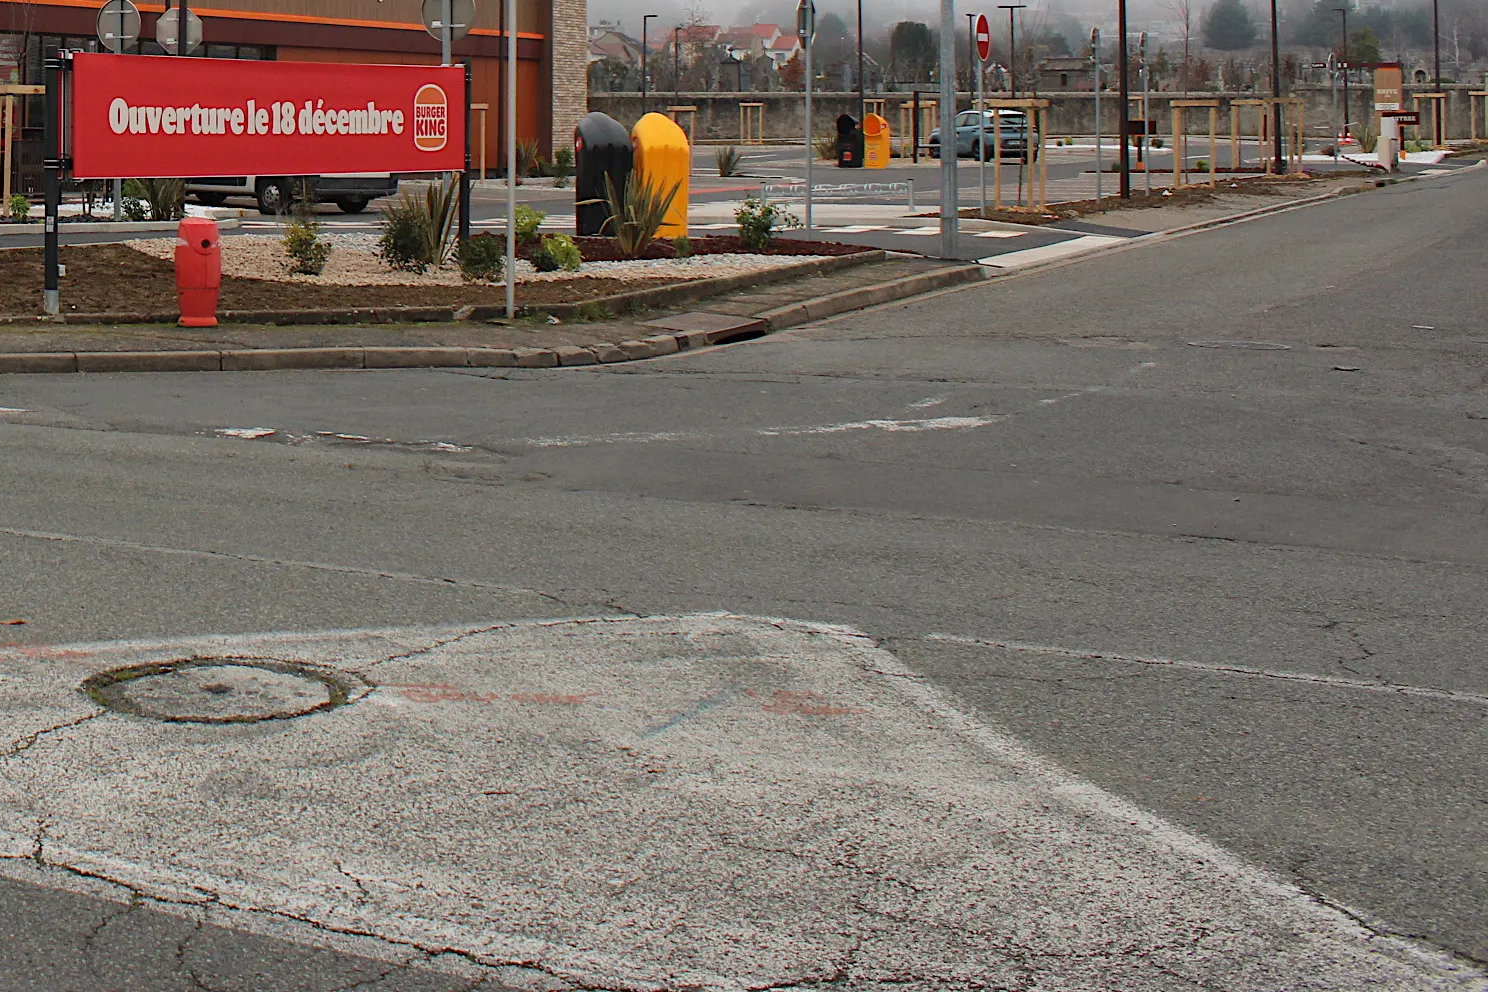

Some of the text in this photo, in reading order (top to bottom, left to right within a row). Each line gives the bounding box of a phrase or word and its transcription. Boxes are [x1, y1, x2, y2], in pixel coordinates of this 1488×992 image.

[109, 97, 404, 135] Ouverture le 18 décembre
[416, 106, 445, 118] BURGER
[416, 119, 445, 136] KING
